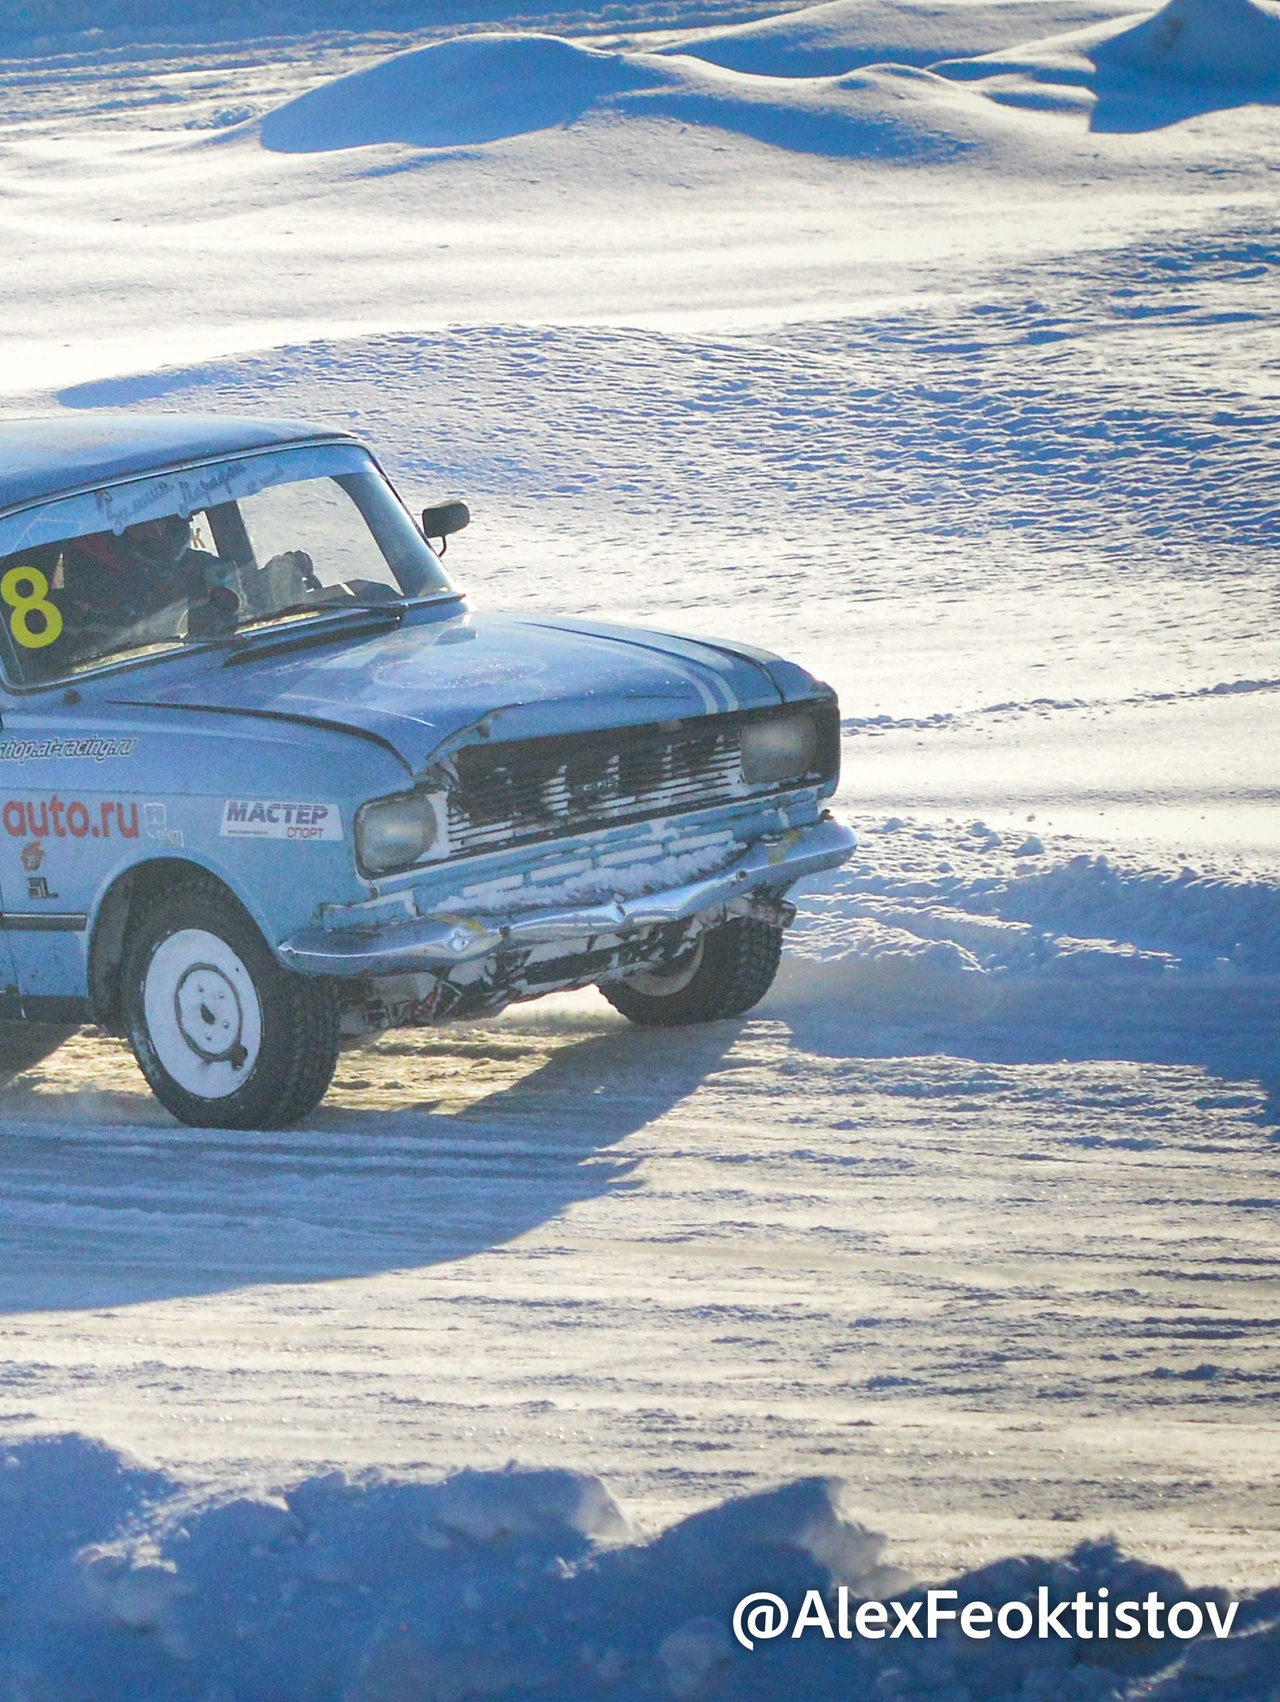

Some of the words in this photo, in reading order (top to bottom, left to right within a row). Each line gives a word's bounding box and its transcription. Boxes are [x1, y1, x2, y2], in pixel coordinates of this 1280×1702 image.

[0, 565, 63, 649] 8
[3, 794, 140, 839] auto.ru
[227, 801, 329, 825] МАСТЕР
[286, 826, 325, 840] СПОРТ
